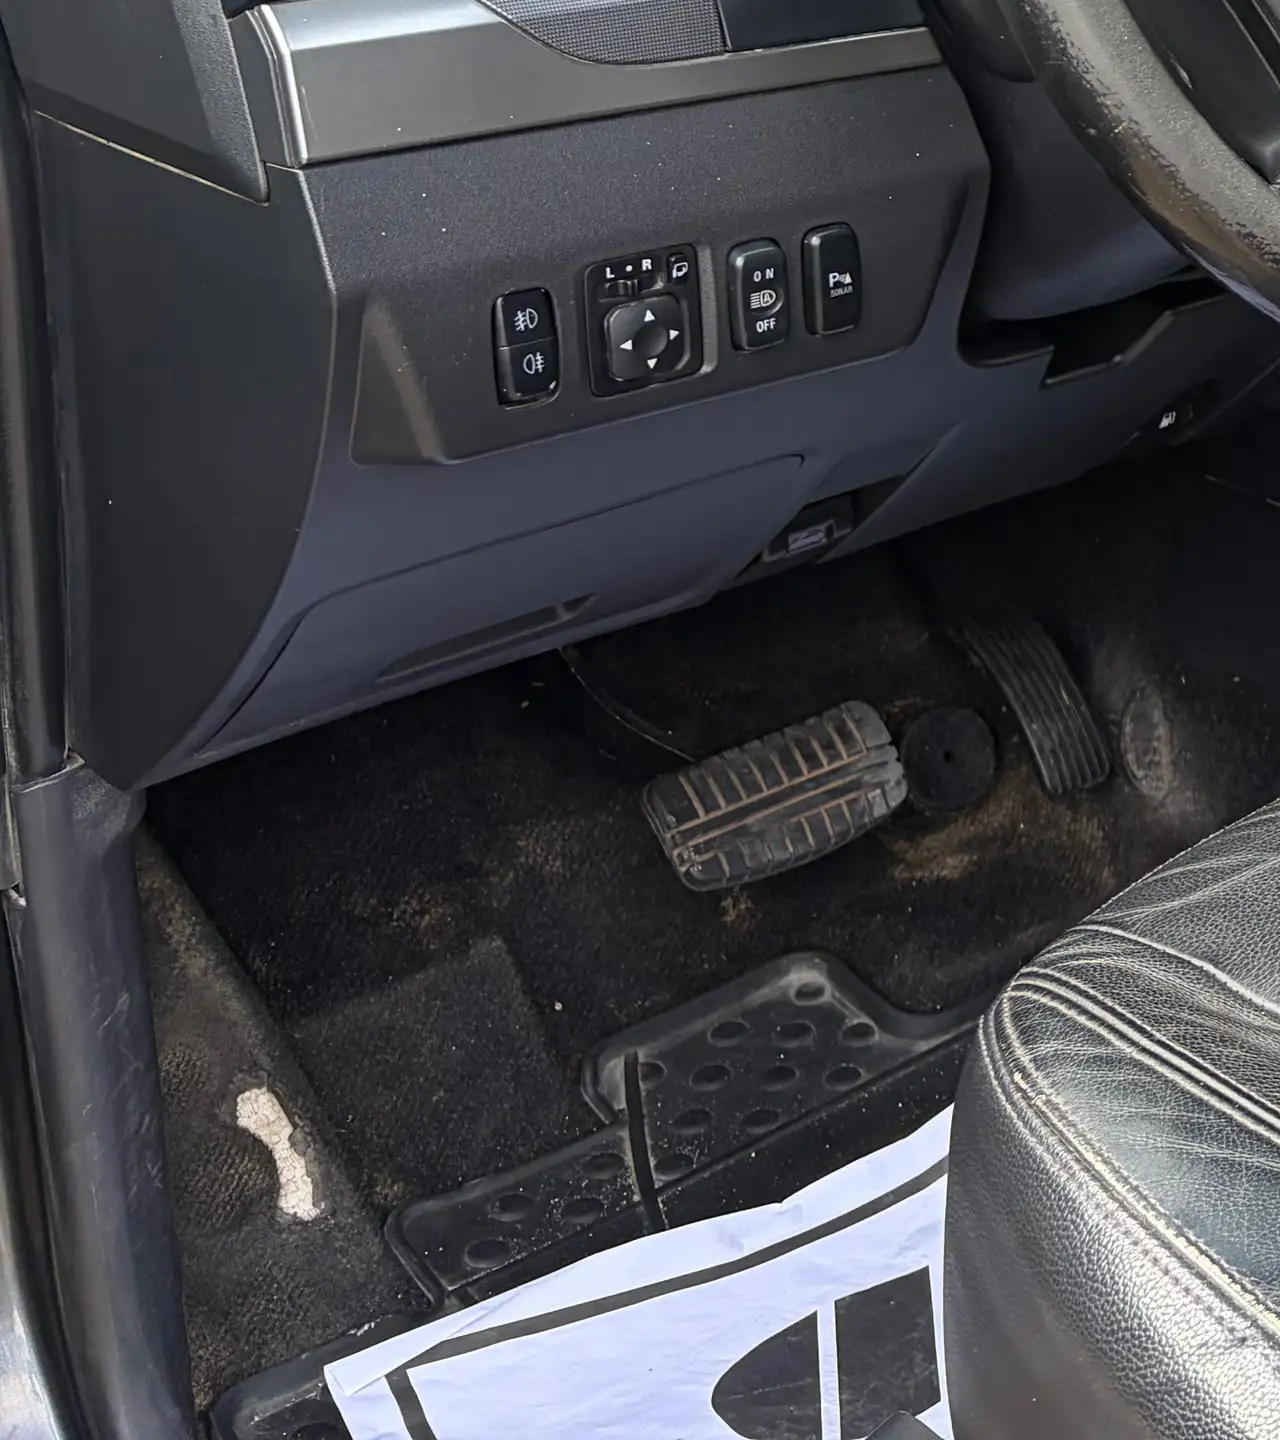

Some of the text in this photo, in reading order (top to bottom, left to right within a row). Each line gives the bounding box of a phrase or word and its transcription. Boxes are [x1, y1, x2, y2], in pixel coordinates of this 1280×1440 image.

[605, 258, 652, 279] L R
[753, 268, 775, 282] ON
[830, 285, 853, 298] SONAR
[756, 318, 776, 332] OFF
